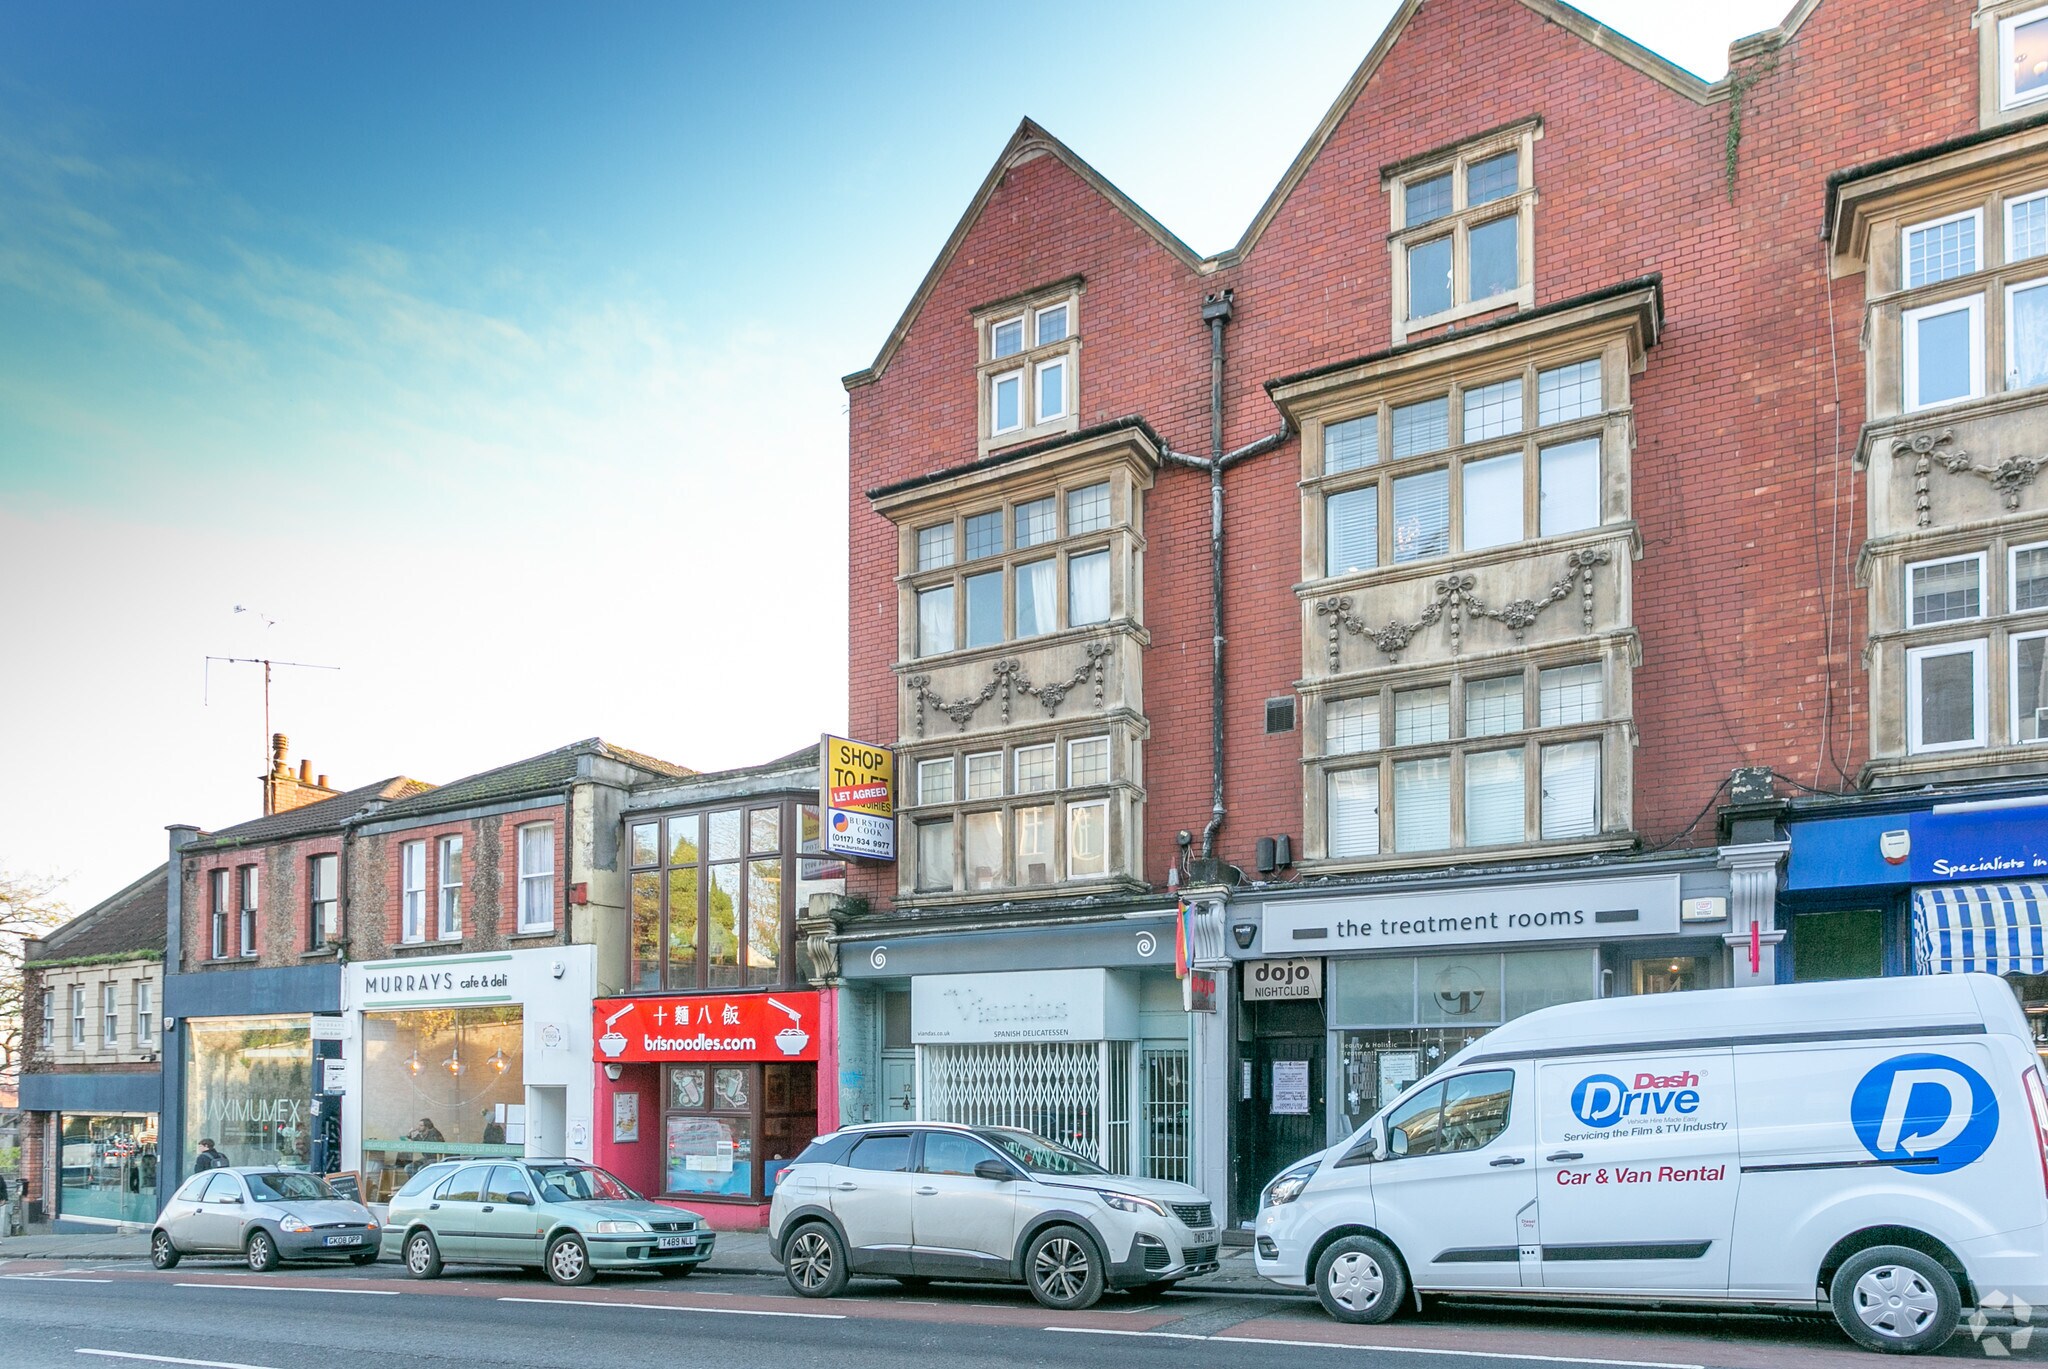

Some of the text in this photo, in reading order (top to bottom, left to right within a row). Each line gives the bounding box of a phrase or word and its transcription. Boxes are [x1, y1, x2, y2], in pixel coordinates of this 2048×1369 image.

[840, 745, 883, 771] SHOP
[834, 768, 856, 787] TO
[834, 787, 887, 802] LET AGREED
[850, 816, 890, 830] BURSTON
[857, 826, 882, 837] COOK
[832, 833, 890, 849] (0117) 934 9977
[1932, 853, 2047, 877] Specialists in
[1336, 909, 1584, 938] the treatment rooms
[365, 972, 508, 993] MURRAYS cafe & deli
[1255, 961, 1309, 985] dojo
[1255, 986, 1310, 997] NIGHTCLUB
[653, 1003, 741, 1026] 十麵八飯
[644, 1033, 756, 1051] brisnoodles.com
[994, 1030, 1021, 1038] SPANISH
[1023, 1029, 1069, 1037] DELICATESSEN
[1341, 1042, 1363, 1050] Beauty
[1634, 1071, 1699, 1090] Dash
[1581, 1082, 1700, 1120] Drive
[1683, 1116, 1698, 1124] Easy
[1564, 1121, 1728, 1142] Servicing the Film & TV Industry
[1556, 1165, 1726, 1186] Car & Van Rental
